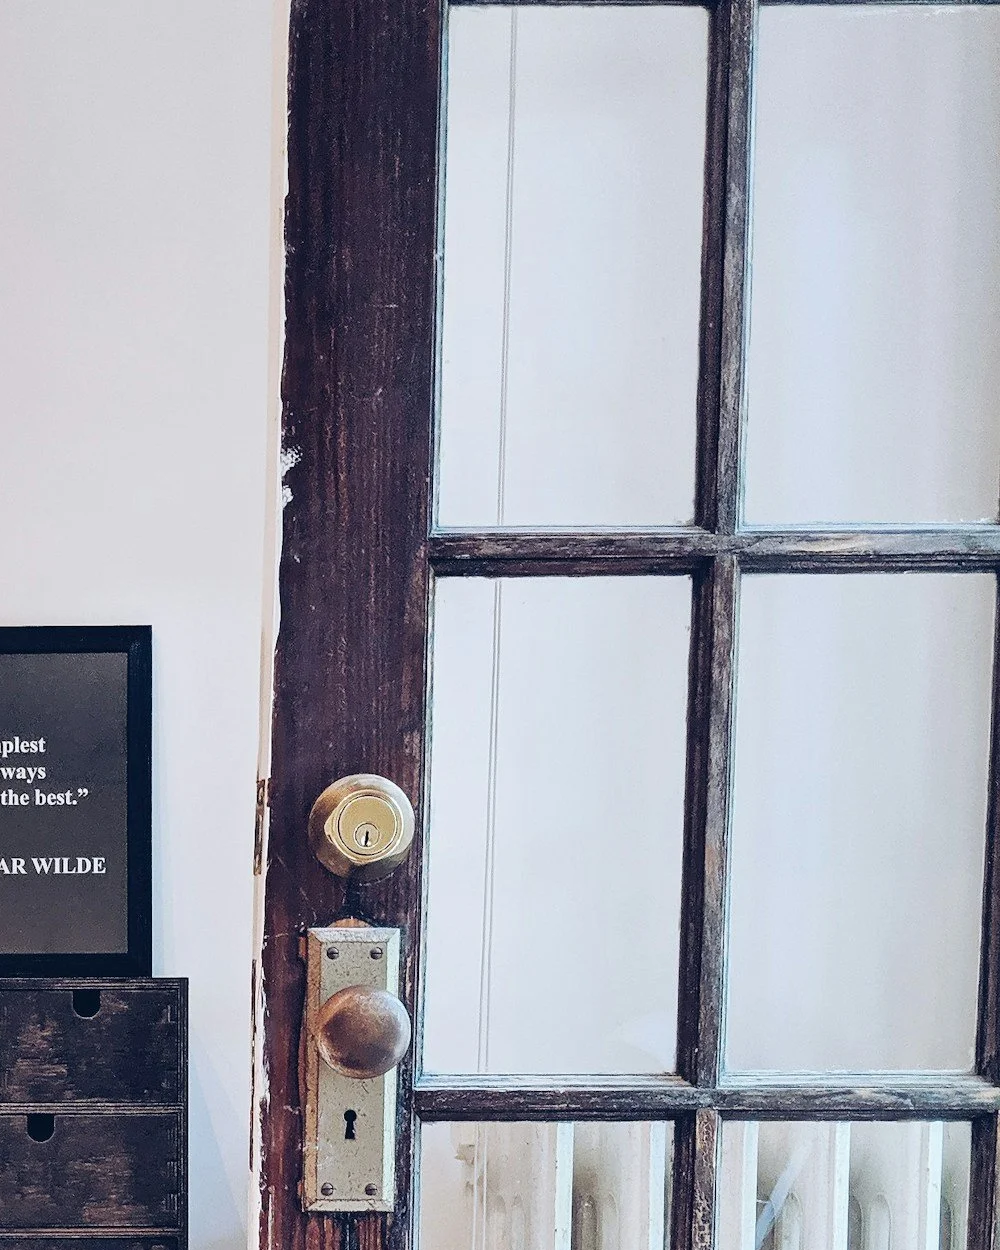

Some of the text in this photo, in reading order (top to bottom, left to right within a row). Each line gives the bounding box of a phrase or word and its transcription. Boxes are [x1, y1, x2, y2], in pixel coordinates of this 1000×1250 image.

[0, 789, 30, 806] the
[35, 788, 89, 806] best.”
[31, 857, 106, 875] WILDE
